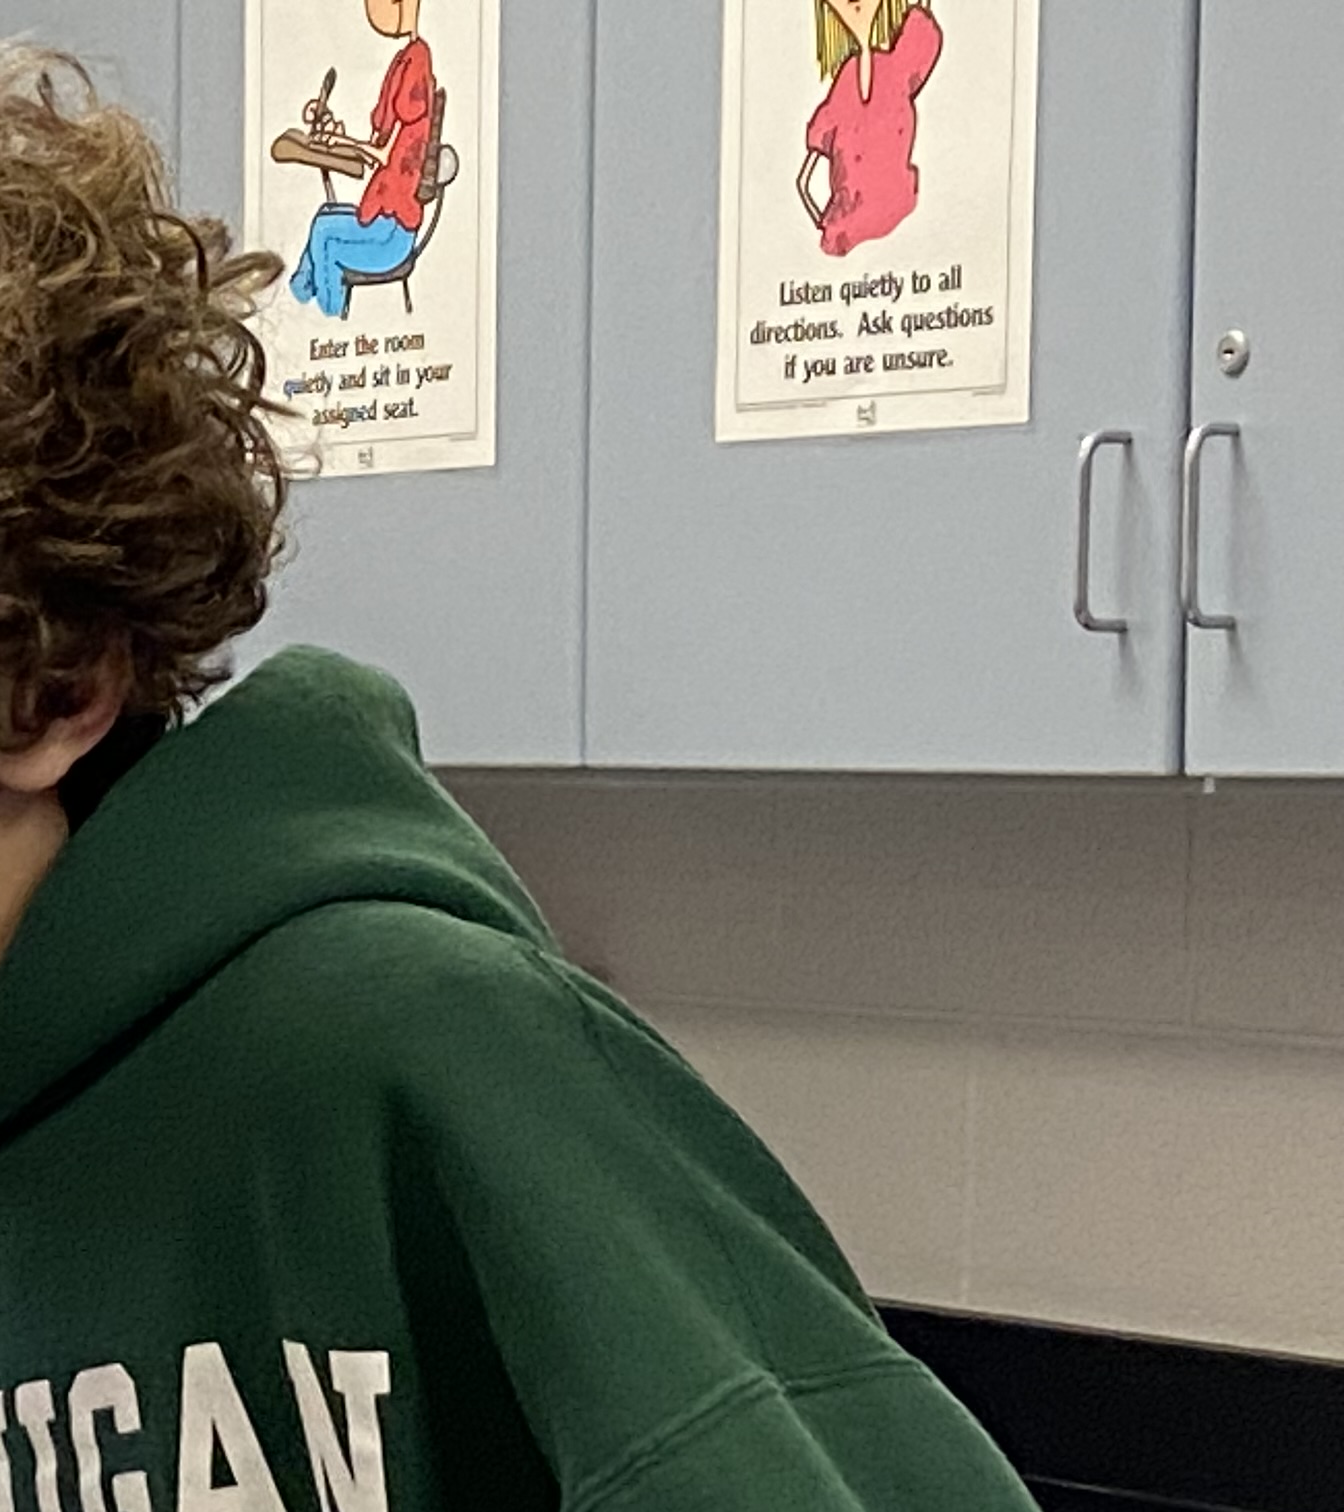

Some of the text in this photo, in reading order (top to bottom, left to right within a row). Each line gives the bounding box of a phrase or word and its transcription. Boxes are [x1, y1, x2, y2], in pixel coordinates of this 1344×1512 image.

[779, 264, 962, 307] Listen quietly to all
[750, 302, 994, 345] directions. Ask questions
[310, 333, 425, 360] Enter the room
[338, 366, 366, 391] and
[372, 364, 391, 387] sit
[396, 363, 410, 385] in
[415, 364, 453, 389] your
[784, 348, 954, 384] if you are unsure.
[312, 397, 419, 428] assigned seat.
